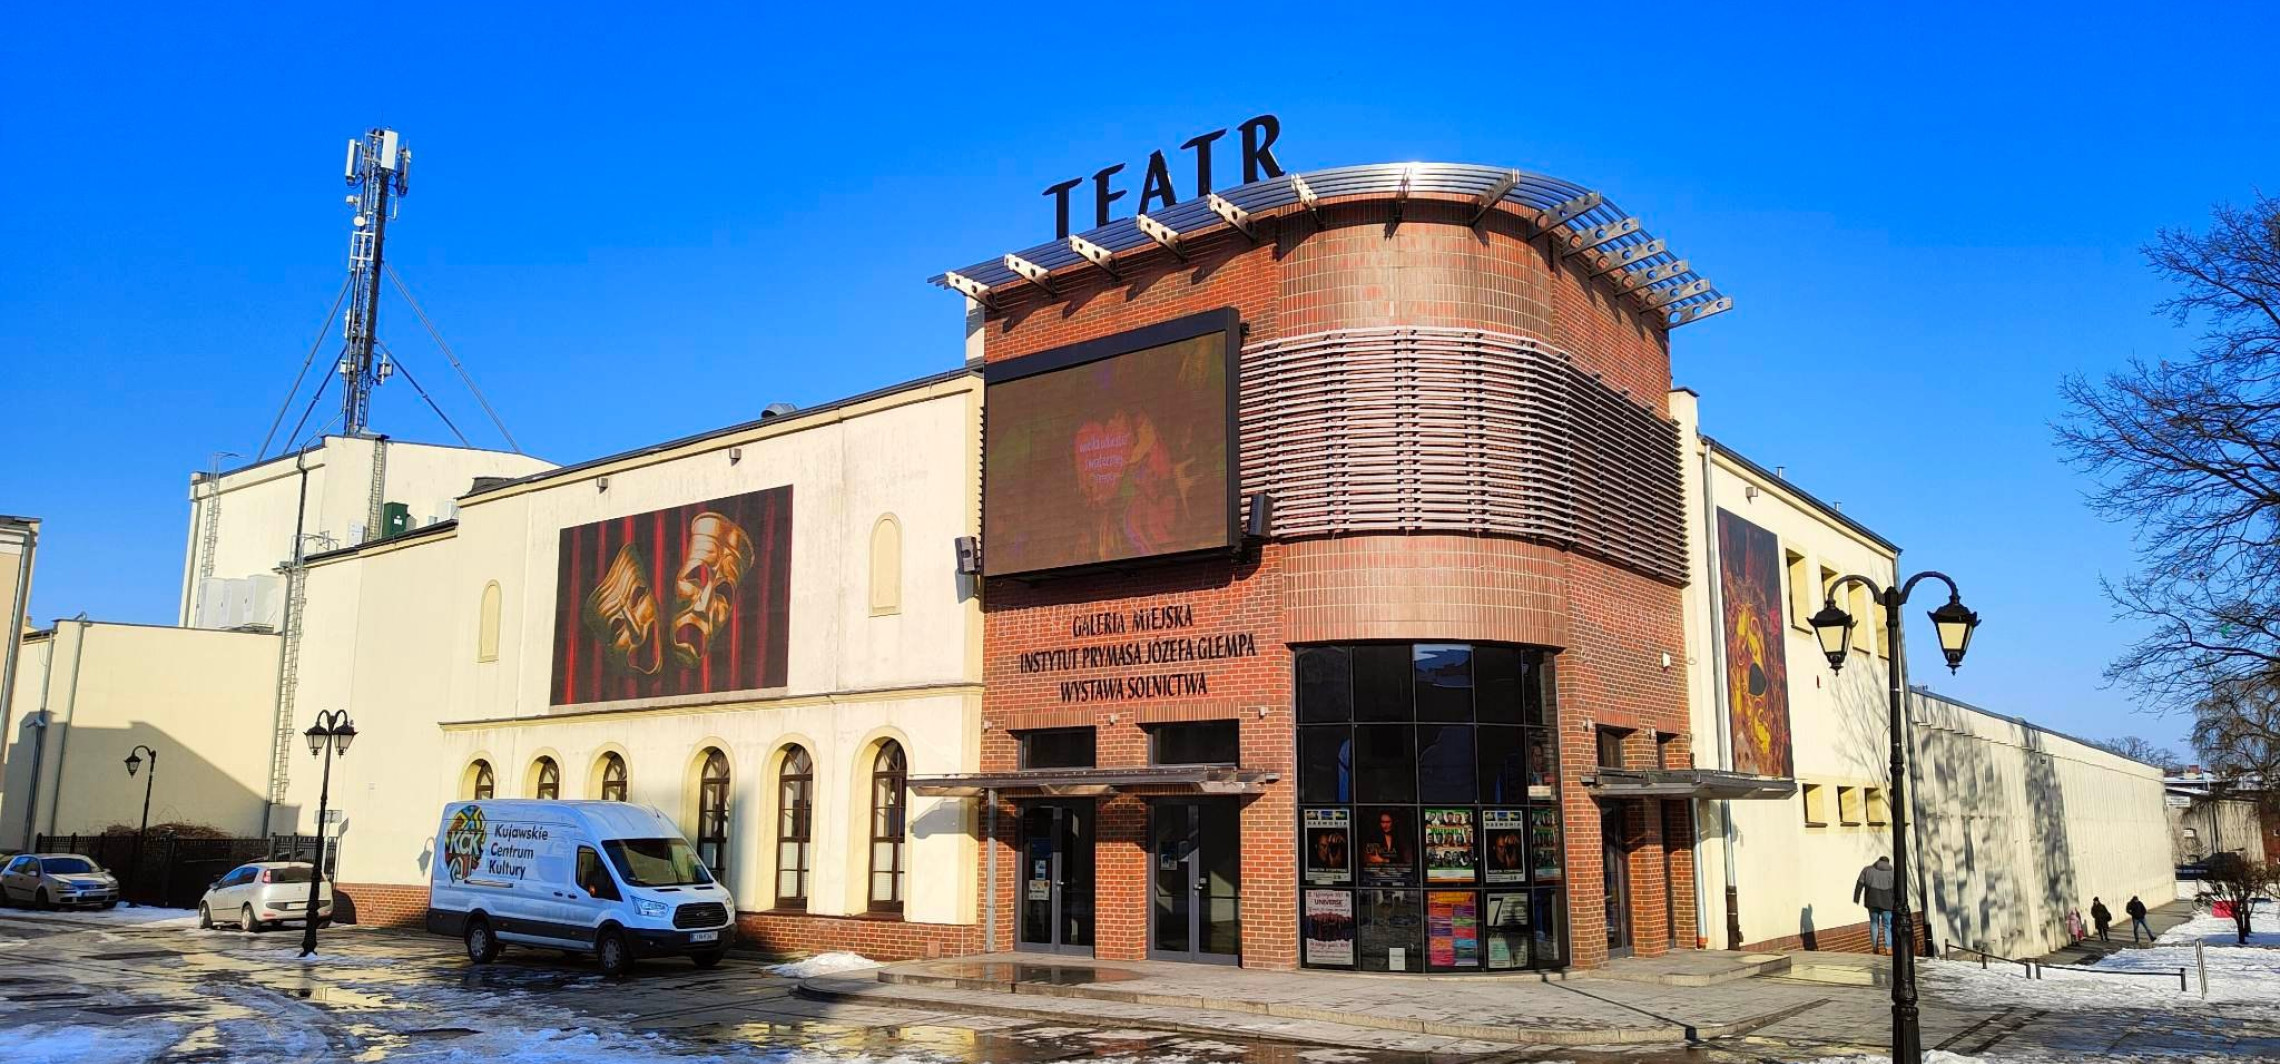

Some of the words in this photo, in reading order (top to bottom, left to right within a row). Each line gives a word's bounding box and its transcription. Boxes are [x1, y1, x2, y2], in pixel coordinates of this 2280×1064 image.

[1042, 113, 1287, 240] TEATR
[1072, 612, 1126, 638] GALERIA
[1131, 604, 1194, 632] MIEJSKA
[1020, 647, 1080, 674] INSTYTUT
[1082, 642, 1142, 669] PRYMASA
[1144, 634, 1196, 665] JÓZEFA
[1197, 632, 1257, 660] GLEMPA
[1060, 678, 1125, 703] WYSTAWA
[1126, 671, 1208, 700] SOLNICTWA
[449, 830, 481, 857] KCK
[494, 823, 549, 842] Kujawskie
[490, 842, 534, 860] Centrum
[488, 859, 527, 881] Kultury
[1490, 897, 1504, 926] 7
